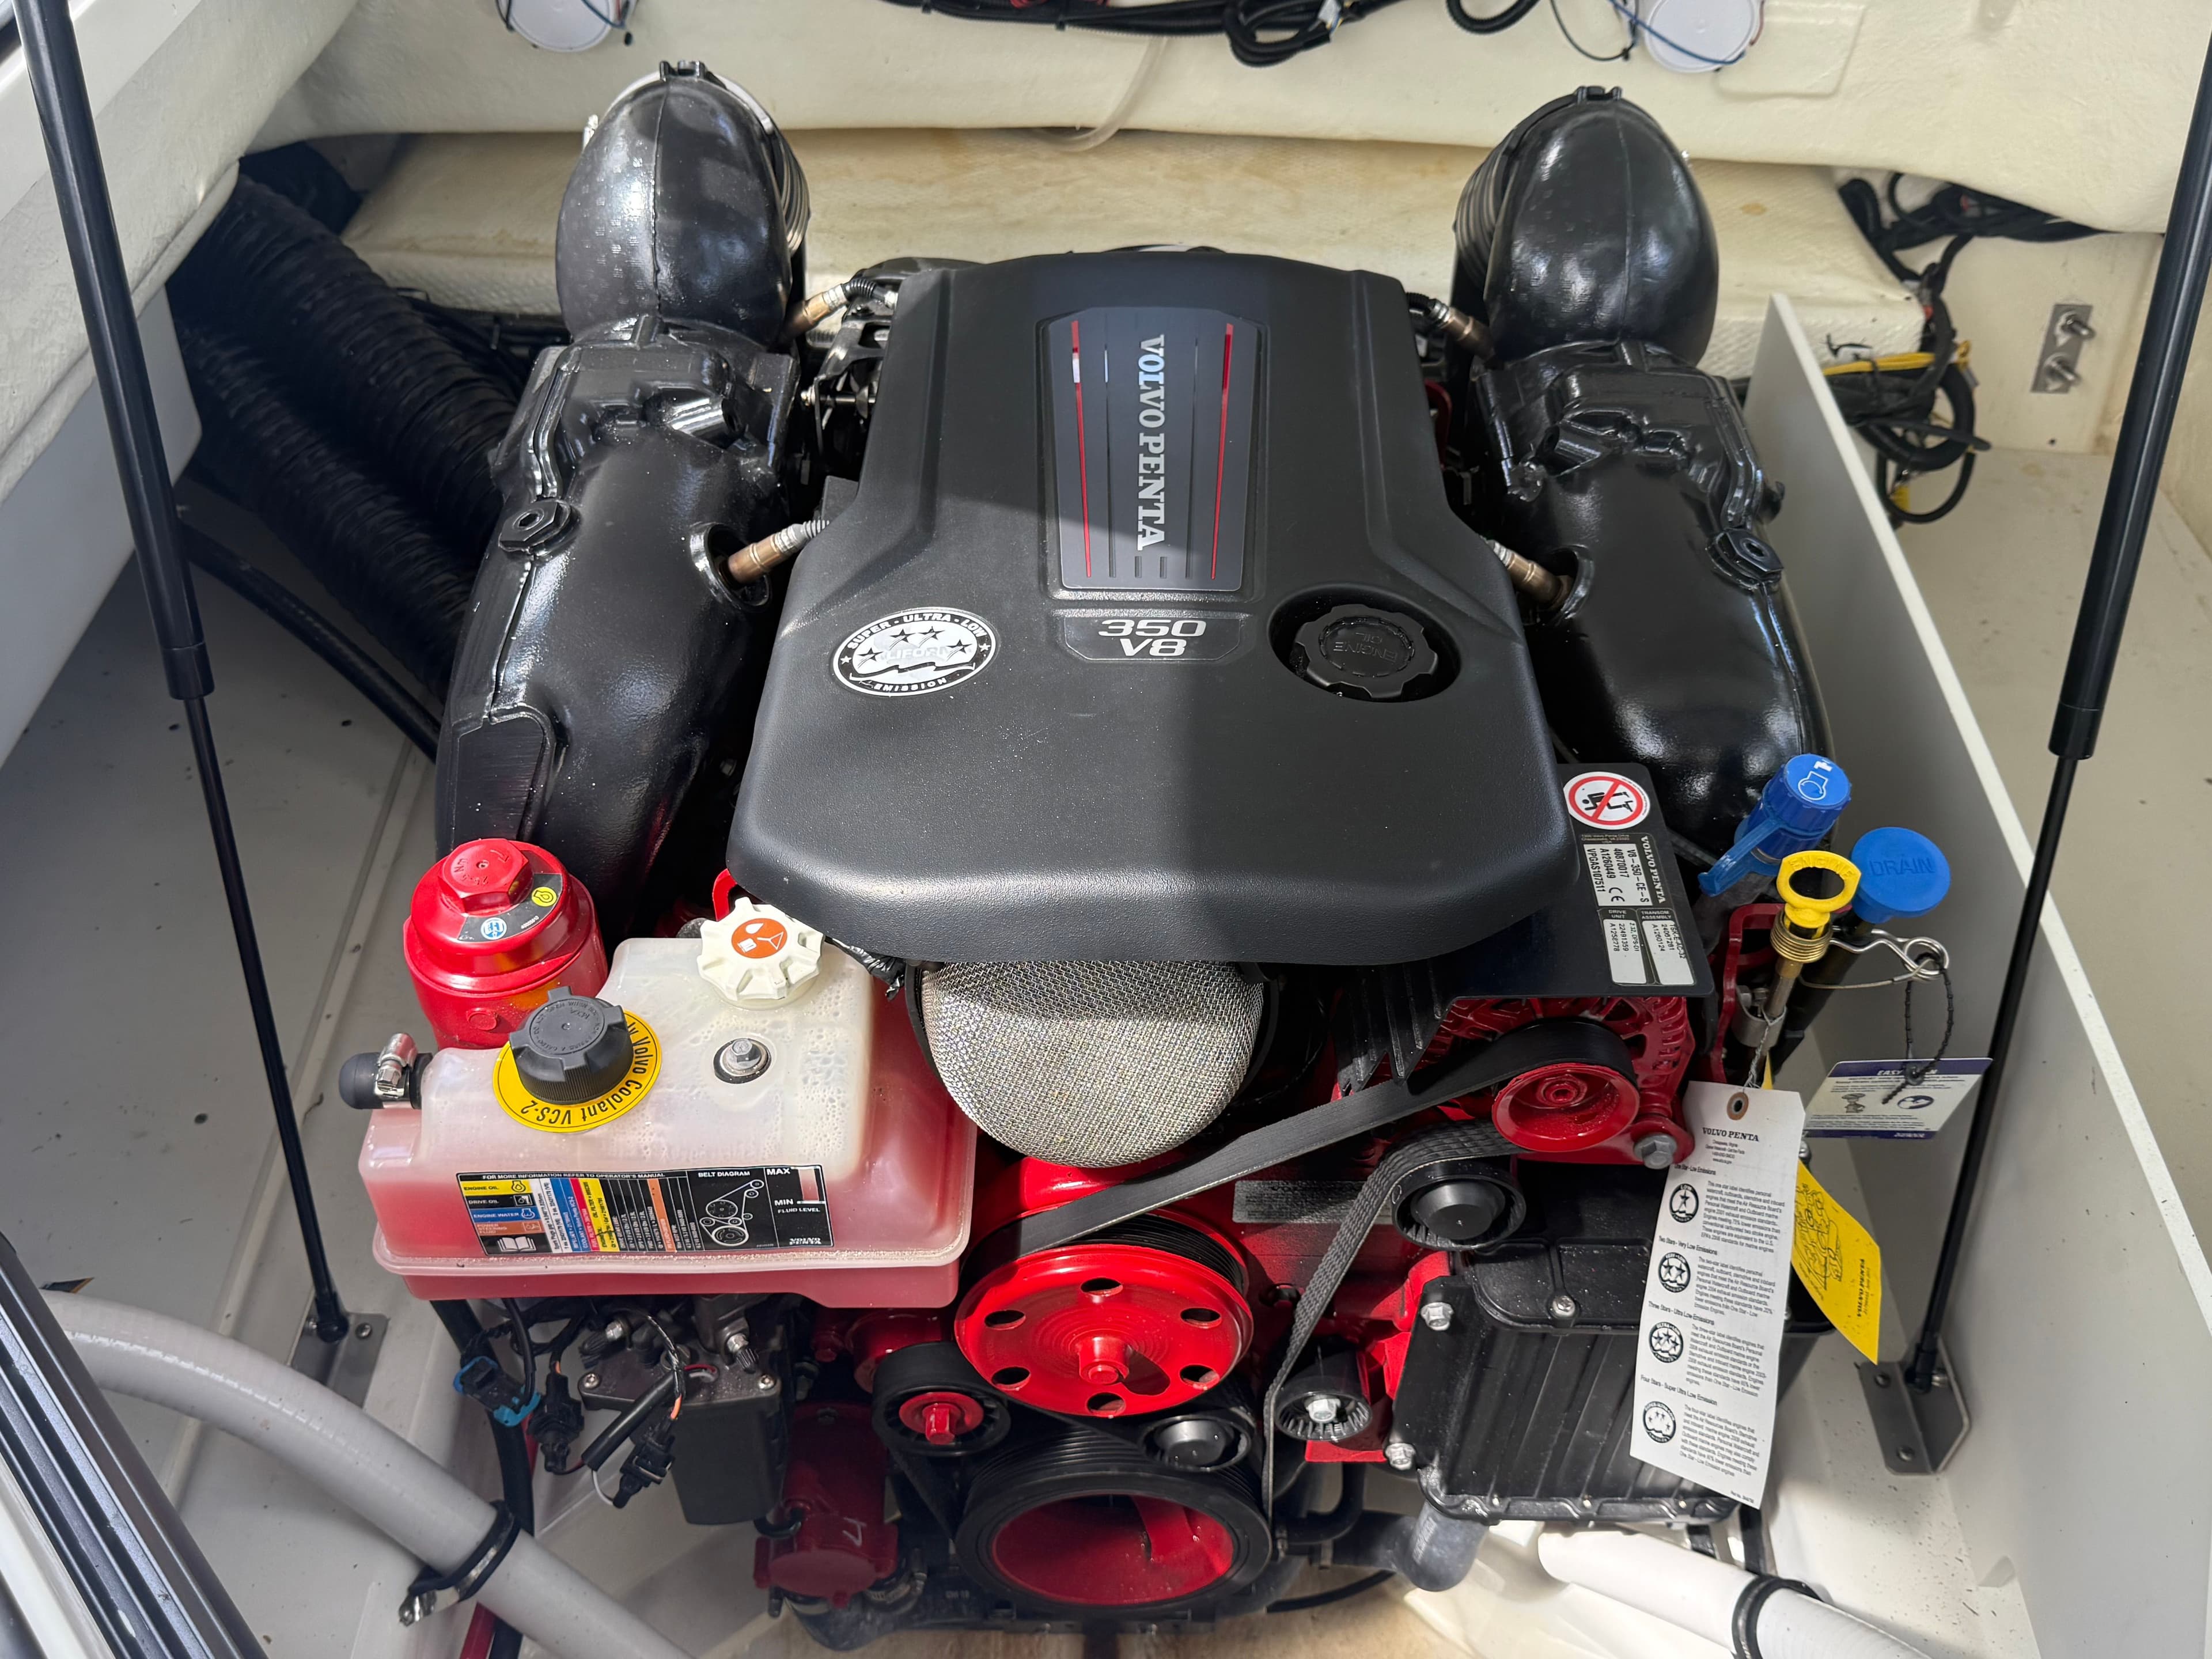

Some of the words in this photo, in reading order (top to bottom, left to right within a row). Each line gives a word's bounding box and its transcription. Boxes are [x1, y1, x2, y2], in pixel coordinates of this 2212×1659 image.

[1138, 334, 1165, 428] VOLVO
[1138, 433, 1165, 551] PENTA
[847, 621, 891, 649] SUPER
[903, 613, 951, 622] ULTRA
[960, 619, 987, 637] LOW
[1097, 619, 1206, 637] 350
[1120, 638, 1187, 657] V8
[1332, 641, 1398, 662] ENGINE
[1587, 849, 1605, 892] VPGAS107511
[1600, 849, 1616, 878] A1260449
[1613, 848, 1629, 877] 40870017
[1641, 836, 1656, 868] VOLVO
[1650, 868, 1666, 903] PENTA
[1872, 858, 1935, 876] DRAIN
[632, 1036, 653, 1074] Volvo
[521, 1100, 571, 1124] VCS-2
[580, 1078, 643, 1122] Coolant
[1702, 1127, 1727, 1137] VOLVO
[1728, 1131, 1759, 1142] PENTA
